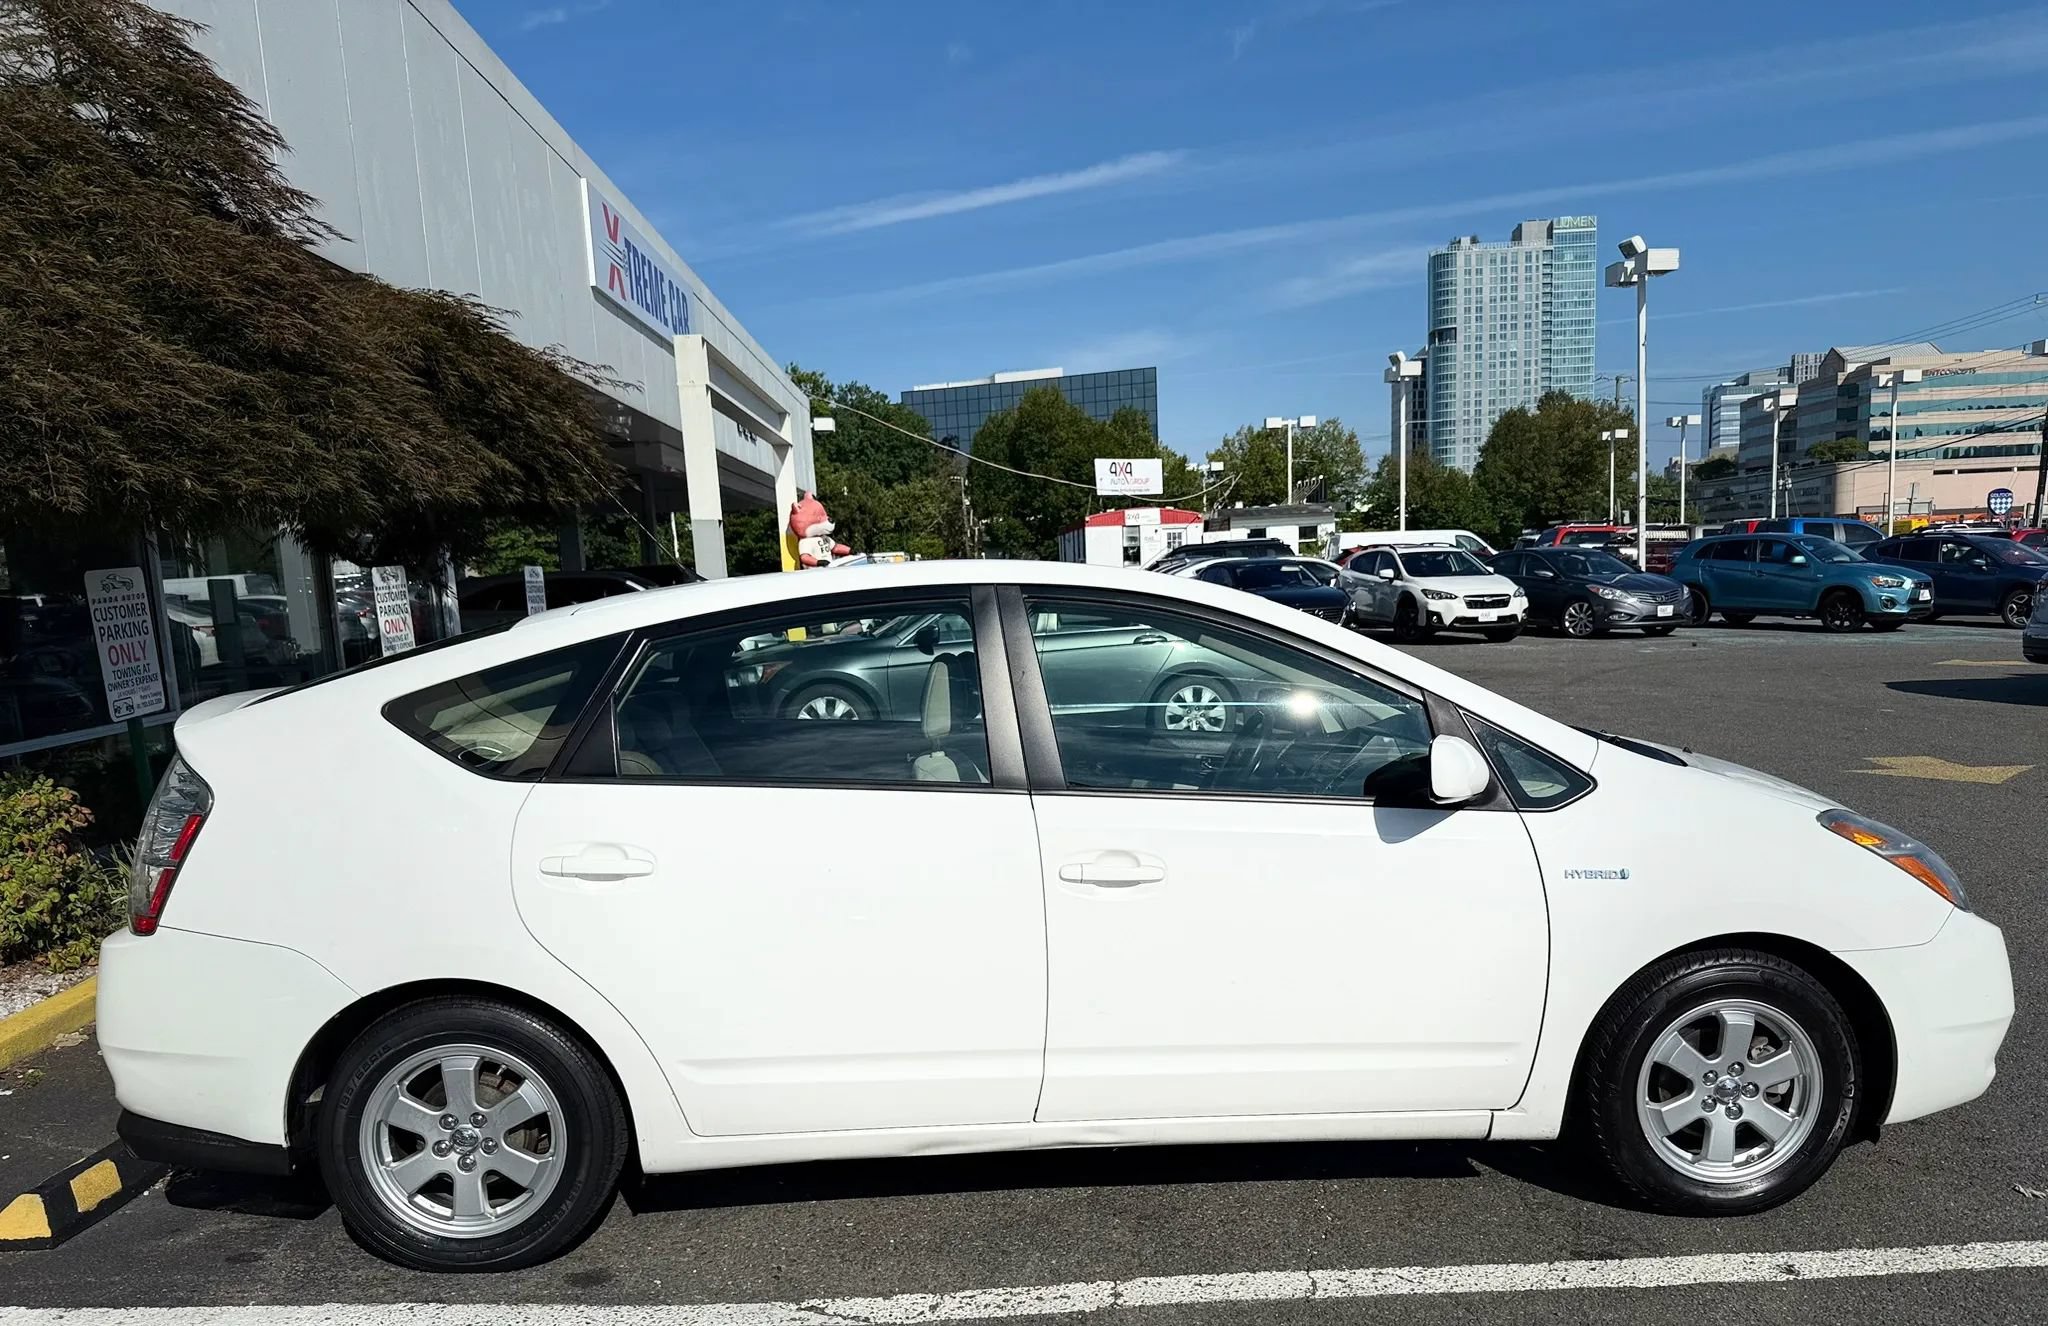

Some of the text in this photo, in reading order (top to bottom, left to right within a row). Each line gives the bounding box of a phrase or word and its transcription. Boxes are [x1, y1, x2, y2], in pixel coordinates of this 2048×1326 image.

[1553, 215, 1597, 228] LUMEN
[668, 279, 690, 335] CAR
[1110, 477, 1150, 486] AUTO GROUP
[376, 590, 408, 604] CUSTOMER
[93, 602, 148, 623] CUSTOMER
[379, 602, 409, 618] PARKING
[98, 620, 150, 643] PARKING
[384, 616, 408, 635] ONLY
[108, 639, 148, 667] ONLY
[112, 663, 151, 681] TOWING AT
[107, 672, 159, 692] OWNER'S EXPENSE
[1564, 869, 1617, 880] HYBRID
